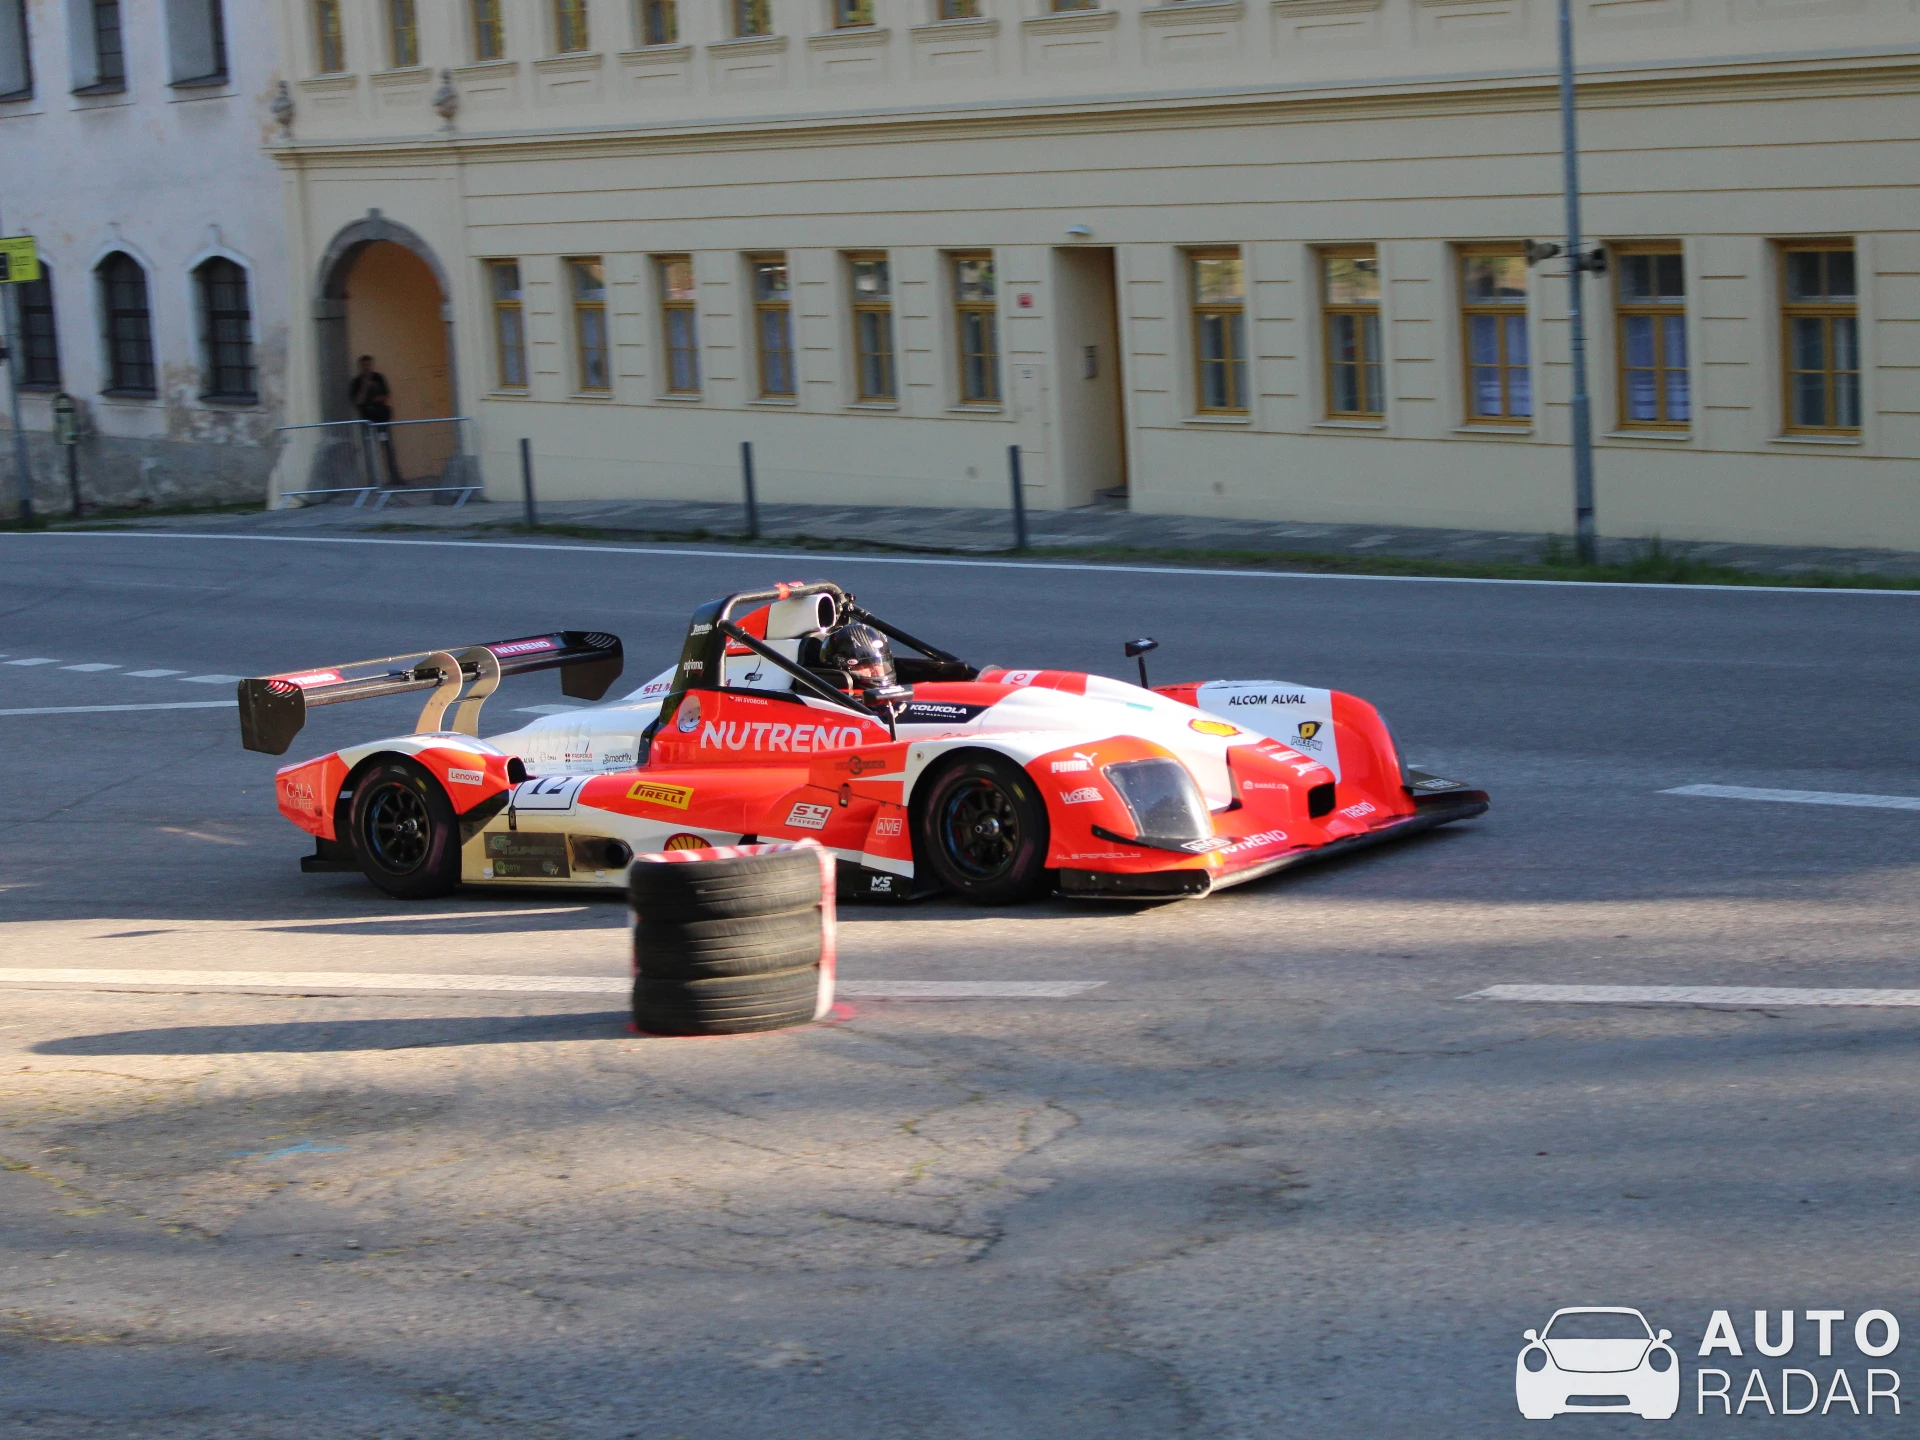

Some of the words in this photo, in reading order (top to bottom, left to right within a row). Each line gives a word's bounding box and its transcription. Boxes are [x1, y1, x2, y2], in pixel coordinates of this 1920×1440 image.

[493, 640, 551, 654] NUTREND
[743, 697, 769, 706] SVOBODA
[1228, 694, 1267, 706] ALCOM
[1271, 694, 1306, 704] ALVAL
[909, 703, 967, 715] KOUKOLA
[700, 720, 863, 753] NUTREND
[451, 771, 480, 782] Lenovo
[286, 782, 314, 799] GALA
[527, 776, 574, 795] 12
[633, 784, 687, 805] PIRELLI
[1339, 801, 1376, 819] TREND
[877, 821, 900, 832] AVE
[871, 876, 893, 888] MS
